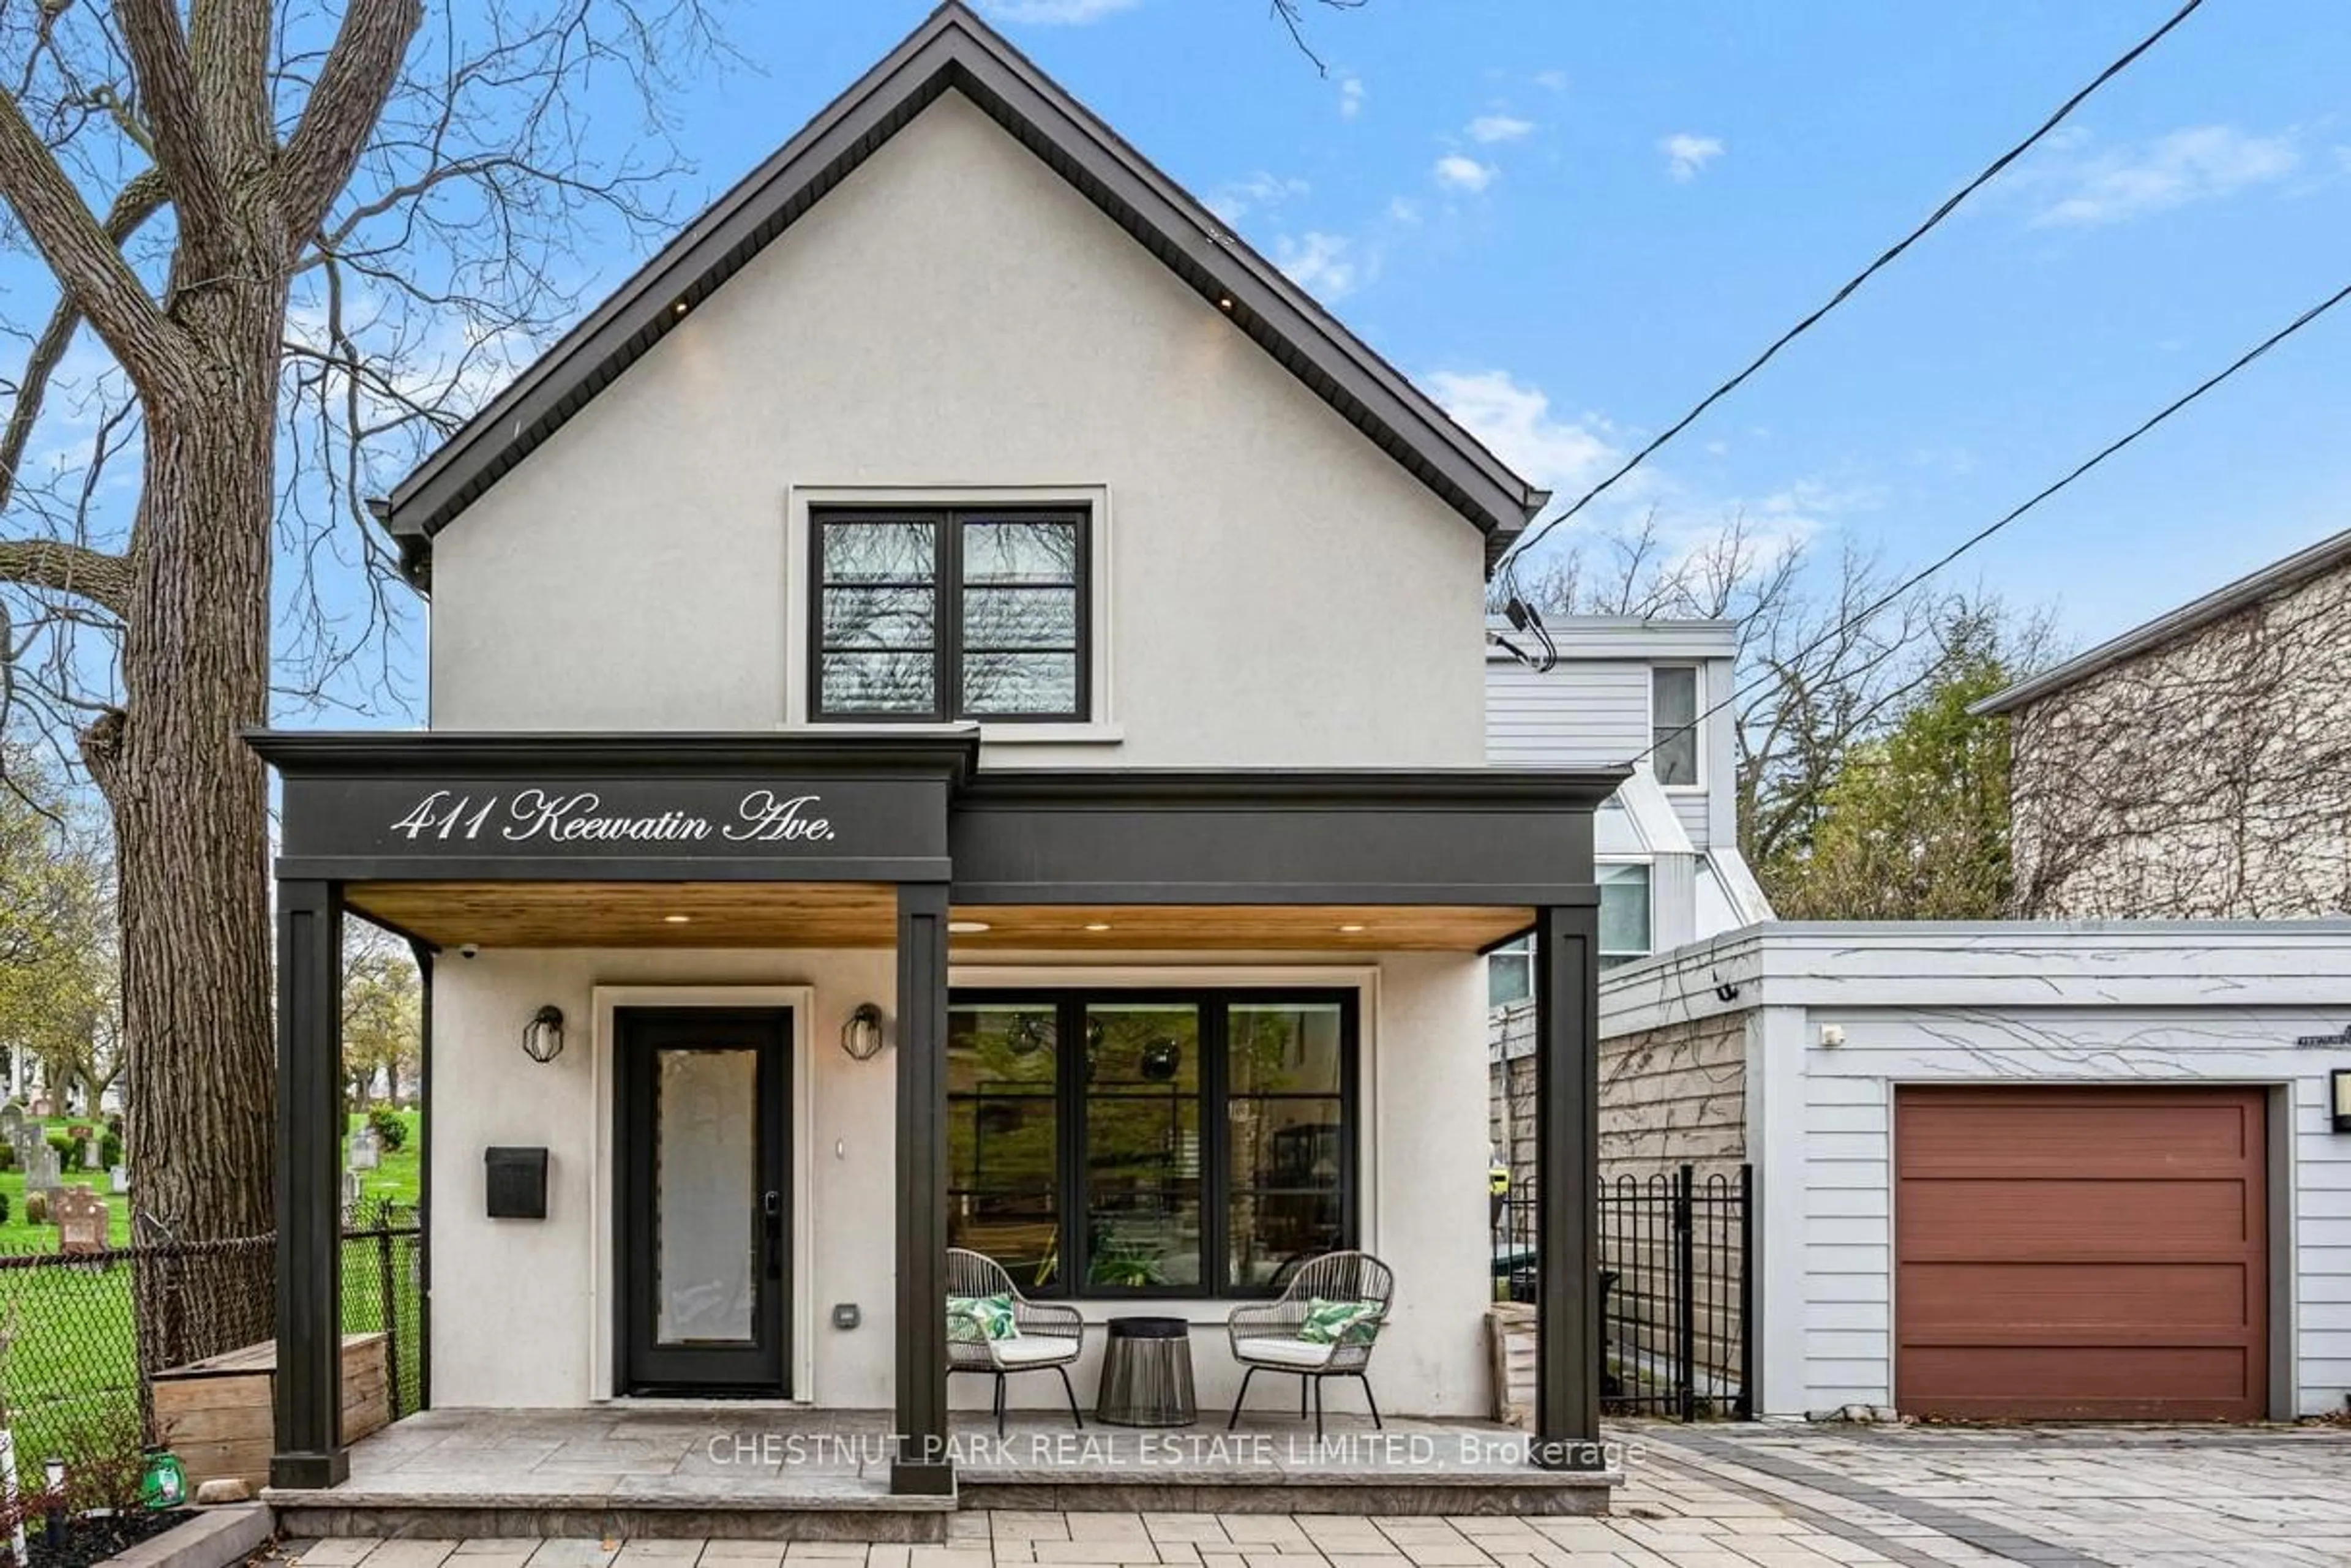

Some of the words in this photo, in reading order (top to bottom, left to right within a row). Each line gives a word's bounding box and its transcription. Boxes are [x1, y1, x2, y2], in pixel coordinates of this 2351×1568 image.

[391, 790, 498, 839] 411
[503, 789, 713, 842] Keewatin
[722, 790, 835, 841] Ave.
